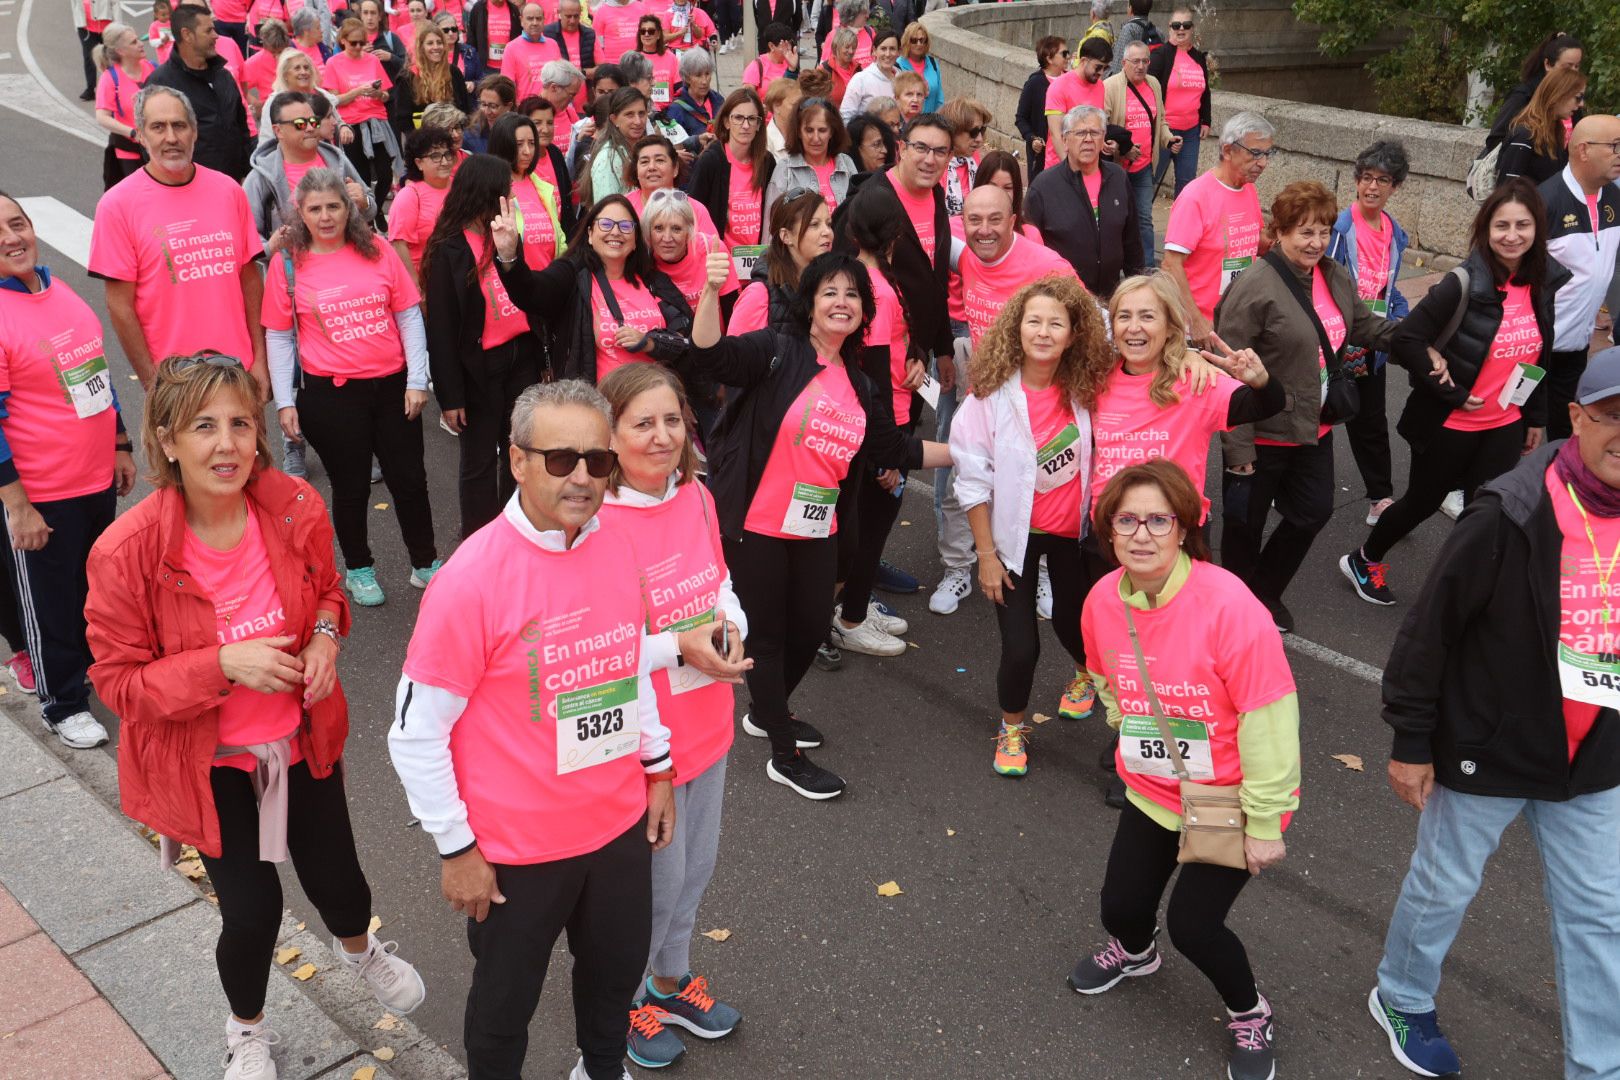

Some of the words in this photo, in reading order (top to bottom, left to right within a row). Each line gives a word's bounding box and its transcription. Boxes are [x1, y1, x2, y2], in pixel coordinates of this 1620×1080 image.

[168, 237, 187, 251] En
[188, 229, 233, 247] marcha
[527, 231, 554, 245] cánc
[174, 246, 223, 265] contra
[224, 243, 235, 257] el
[178, 261, 237, 282] cáncer
[318, 302, 337, 315] En
[338, 292, 387, 311] marcha
[966, 289, 976, 303] En
[977, 297, 1005, 311] marc
[324, 309, 374, 328] contra
[375, 303, 386, 318] el
[623, 307, 660, 321] archa
[330, 318, 390, 343] cáncer
[1494, 327, 1539, 344] contra
[57, 351, 74, 366] En
[1493, 339, 1544, 359] cánce
[86, 375, 106, 397] 1273
[815, 400, 832, 414] En
[832, 409, 867, 428] march
[810, 417, 857, 445] contra
[1096, 428, 1109, 441] En
[1110, 428, 1170, 442] marcha
[803, 434, 858, 463] cánce
[1097, 444, 1145, 460] contra
[1147, 444, 1166, 459] el
[1041, 447, 1076, 476] 1228
[802, 503, 829, 521] 1226
[651, 587, 675, 607] En
[677, 562, 720, 599] march
[1560, 580, 1588, 599] En
[656, 590, 718, 629] contra
[543, 644, 571, 665] En
[575, 621, 636, 654] marcha
[545, 654, 623, 692] contra
[624, 643, 636, 668] el
[527, 648, 542, 723] SALAMANCA
[1117, 674, 1137, 692] En
[1151, 681, 1211, 698] archa
[1188, 700, 1215, 718] el
[577, 708, 624, 742] 5323
[1139, 739, 1191, 760] 532
